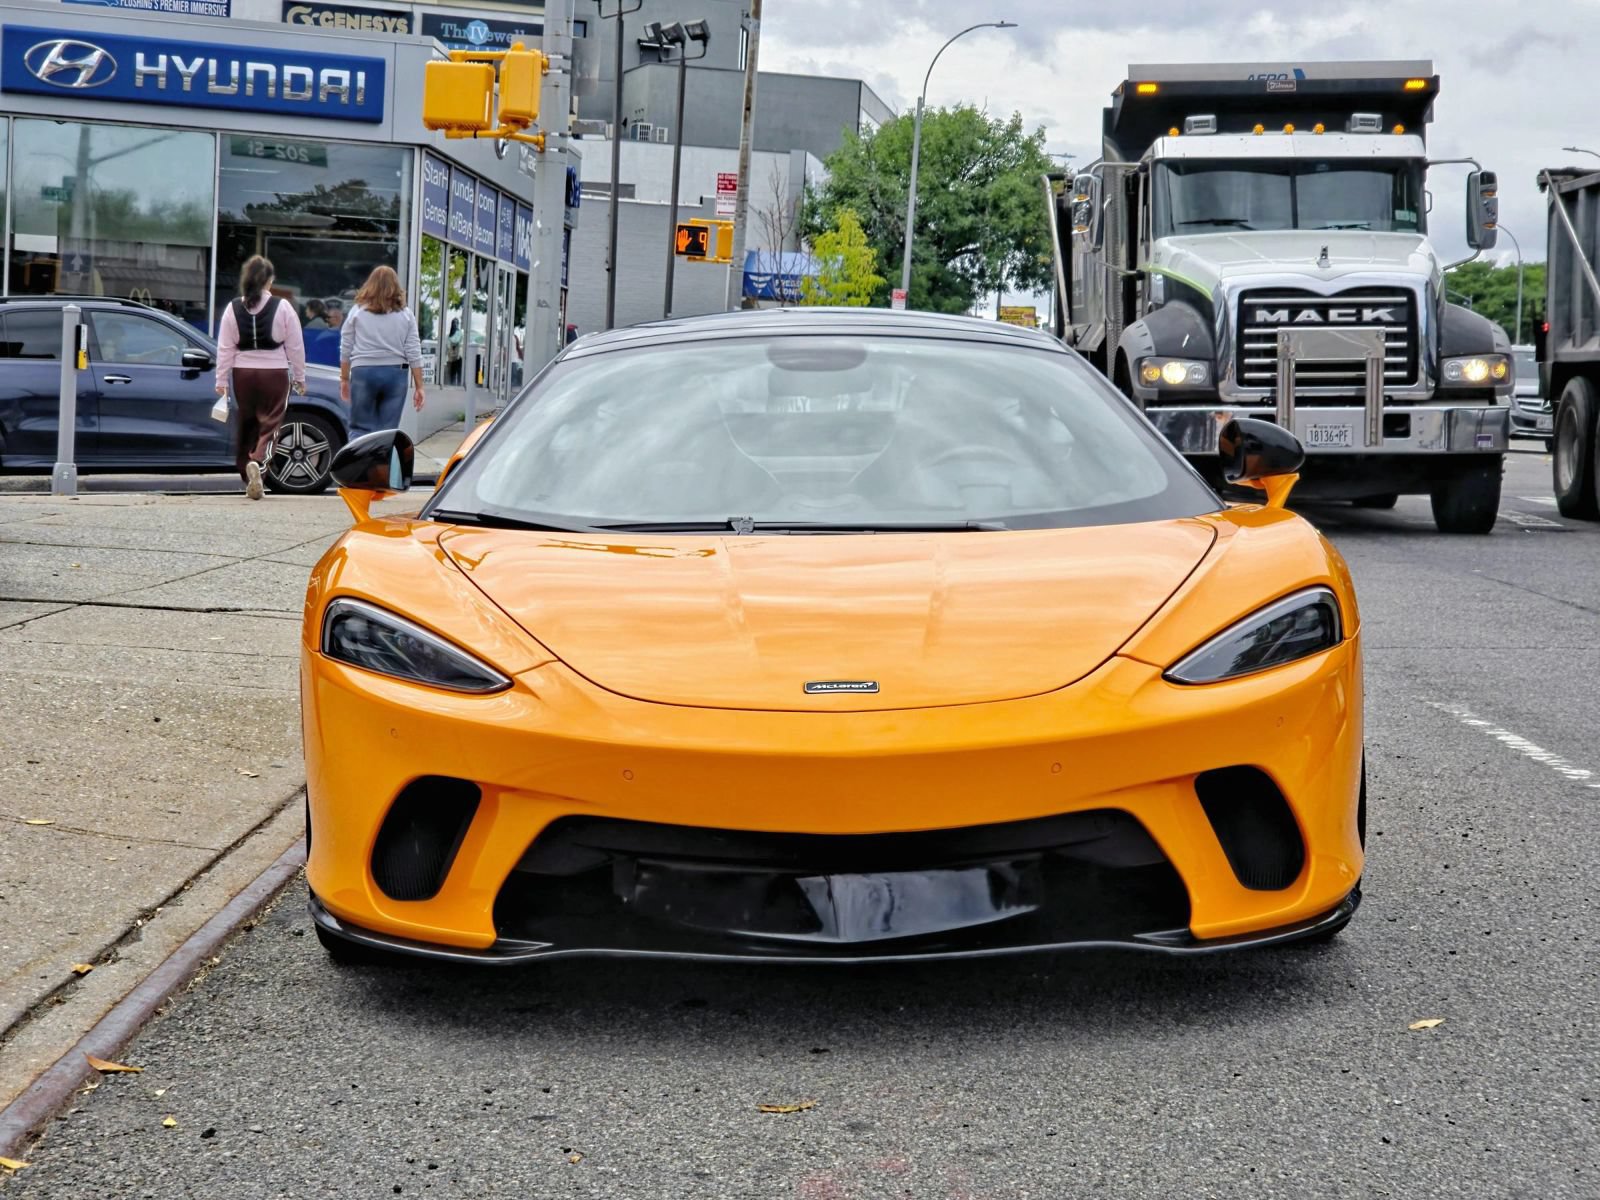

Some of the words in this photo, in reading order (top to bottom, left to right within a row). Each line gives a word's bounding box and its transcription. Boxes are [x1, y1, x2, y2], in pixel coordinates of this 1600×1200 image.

[160, 0, 189, 13] PREMIER
[190, 3, 227, 17] IMMERSIVE
[320, 10, 409, 34] GENESYS
[134, 52, 366, 106] HYUNDAI
[1256, 308, 1396, 323] MACK
[811, 682, 874, 690] McLaren
